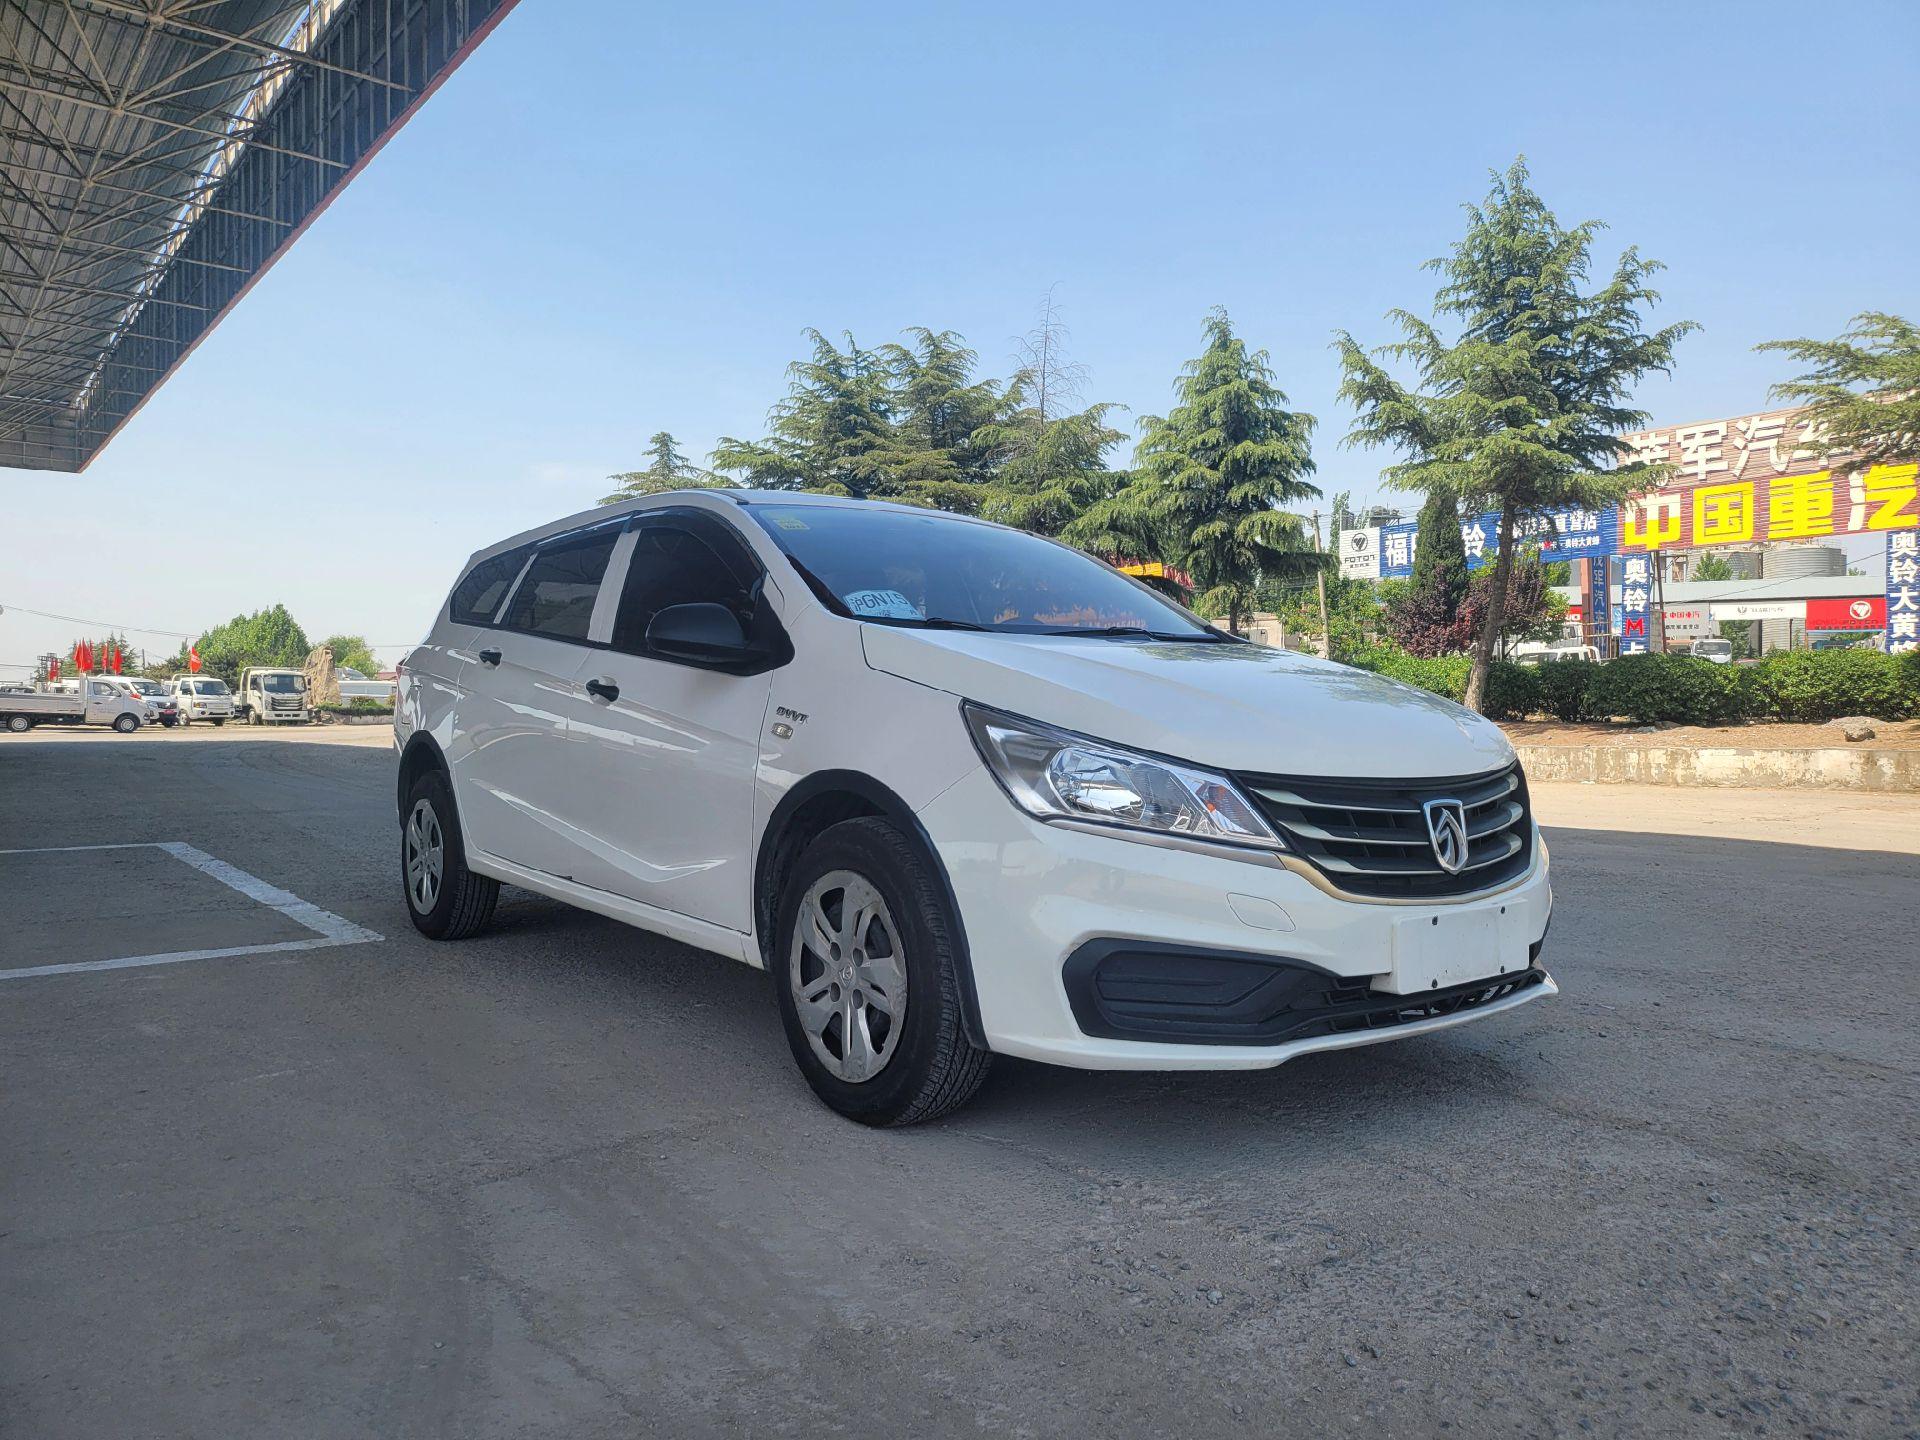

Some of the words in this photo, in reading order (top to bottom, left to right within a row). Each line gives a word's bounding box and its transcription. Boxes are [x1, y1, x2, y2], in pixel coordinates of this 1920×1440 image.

[1624, 464, 1920, 551] 中国重汽
[1385, 523, 1486, 567] 福铃
